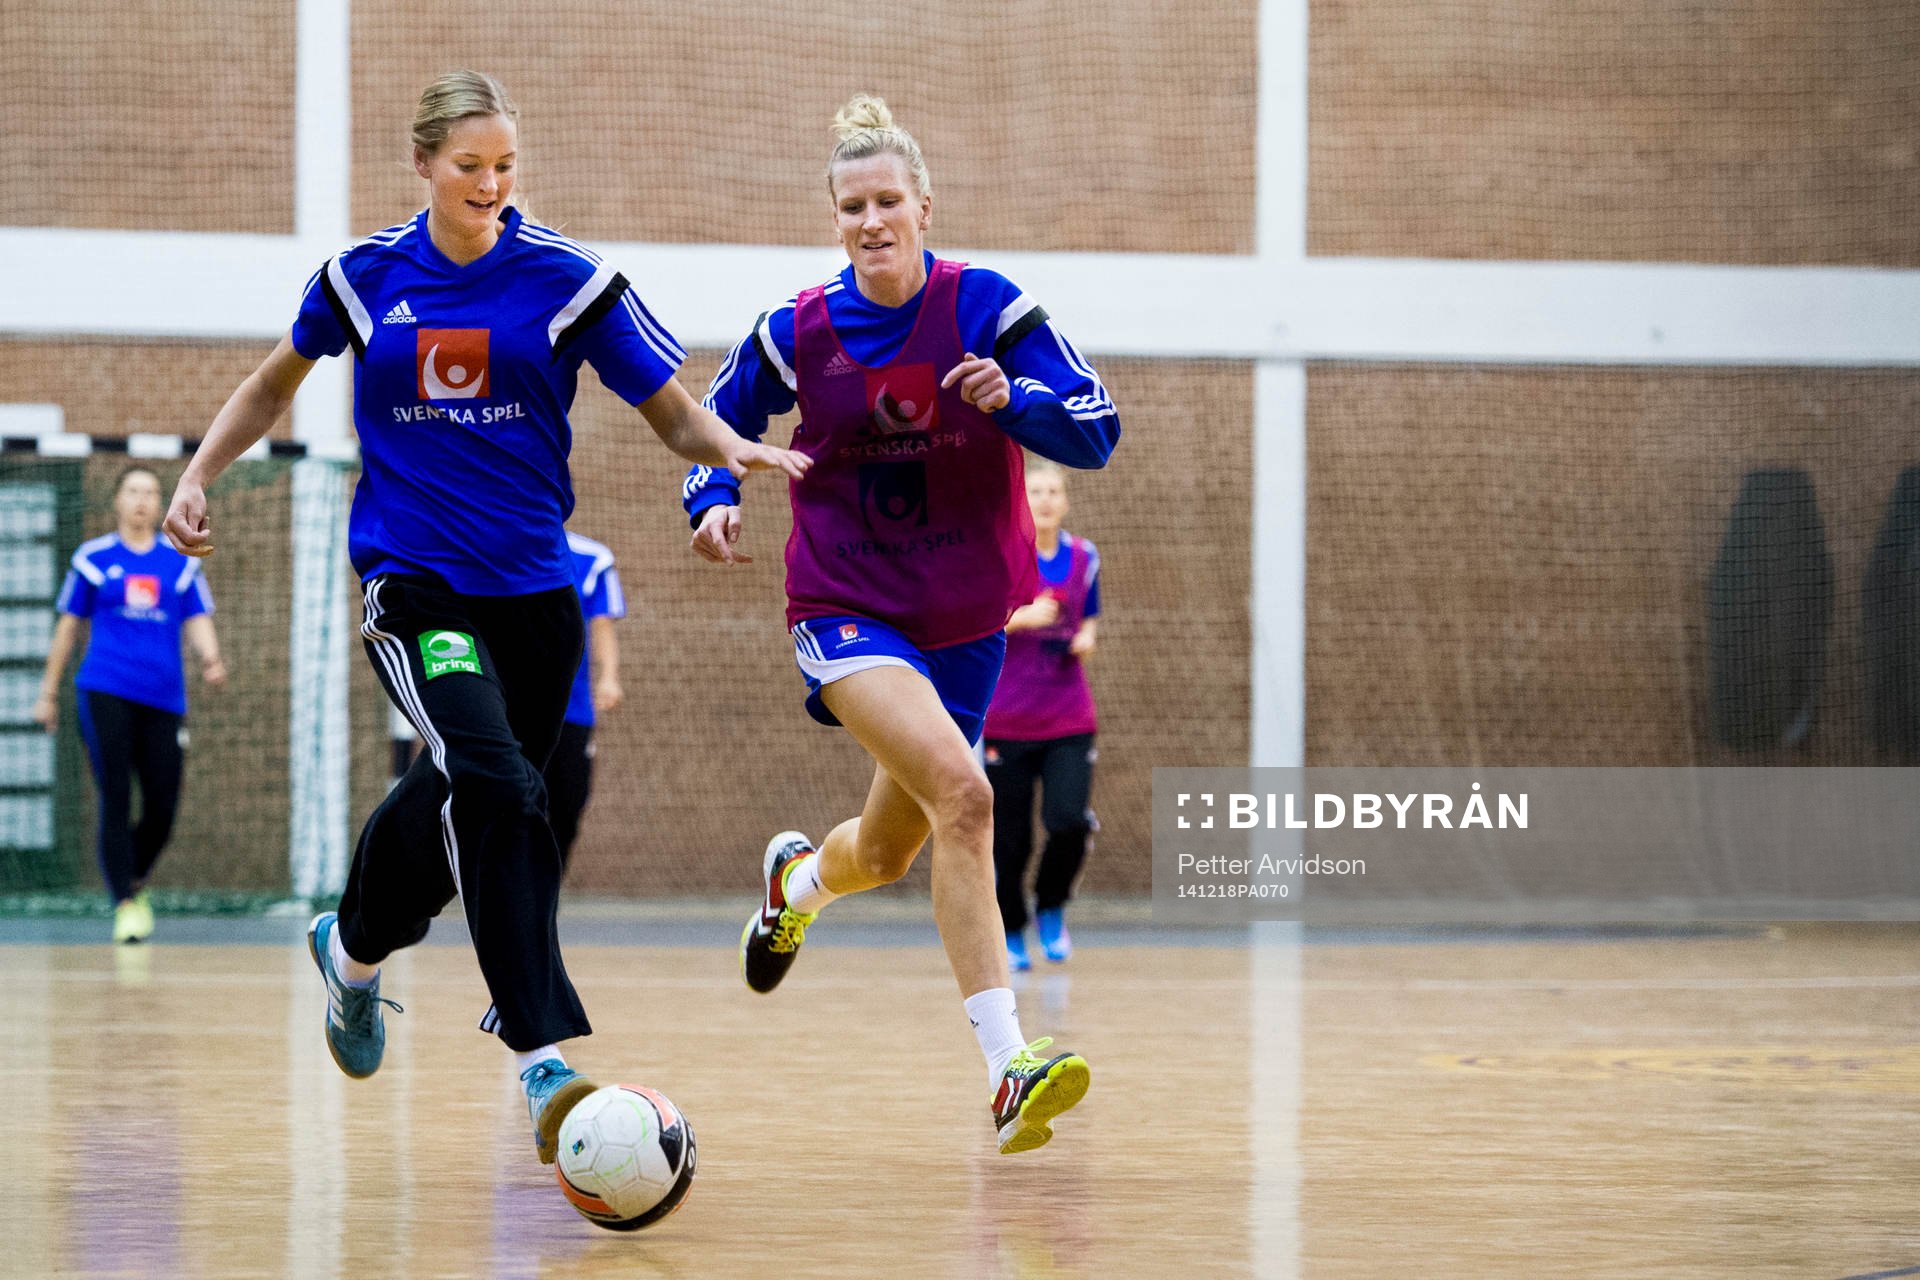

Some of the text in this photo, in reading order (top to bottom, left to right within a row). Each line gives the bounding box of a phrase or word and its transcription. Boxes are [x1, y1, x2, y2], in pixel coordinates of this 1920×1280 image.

[383, 315, 417, 324] adidas
[482, 402, 526, 423] SPEL
[839, 429, 968, 458] SVENSKA SPEL
[432, 659, 475, 672] bring
